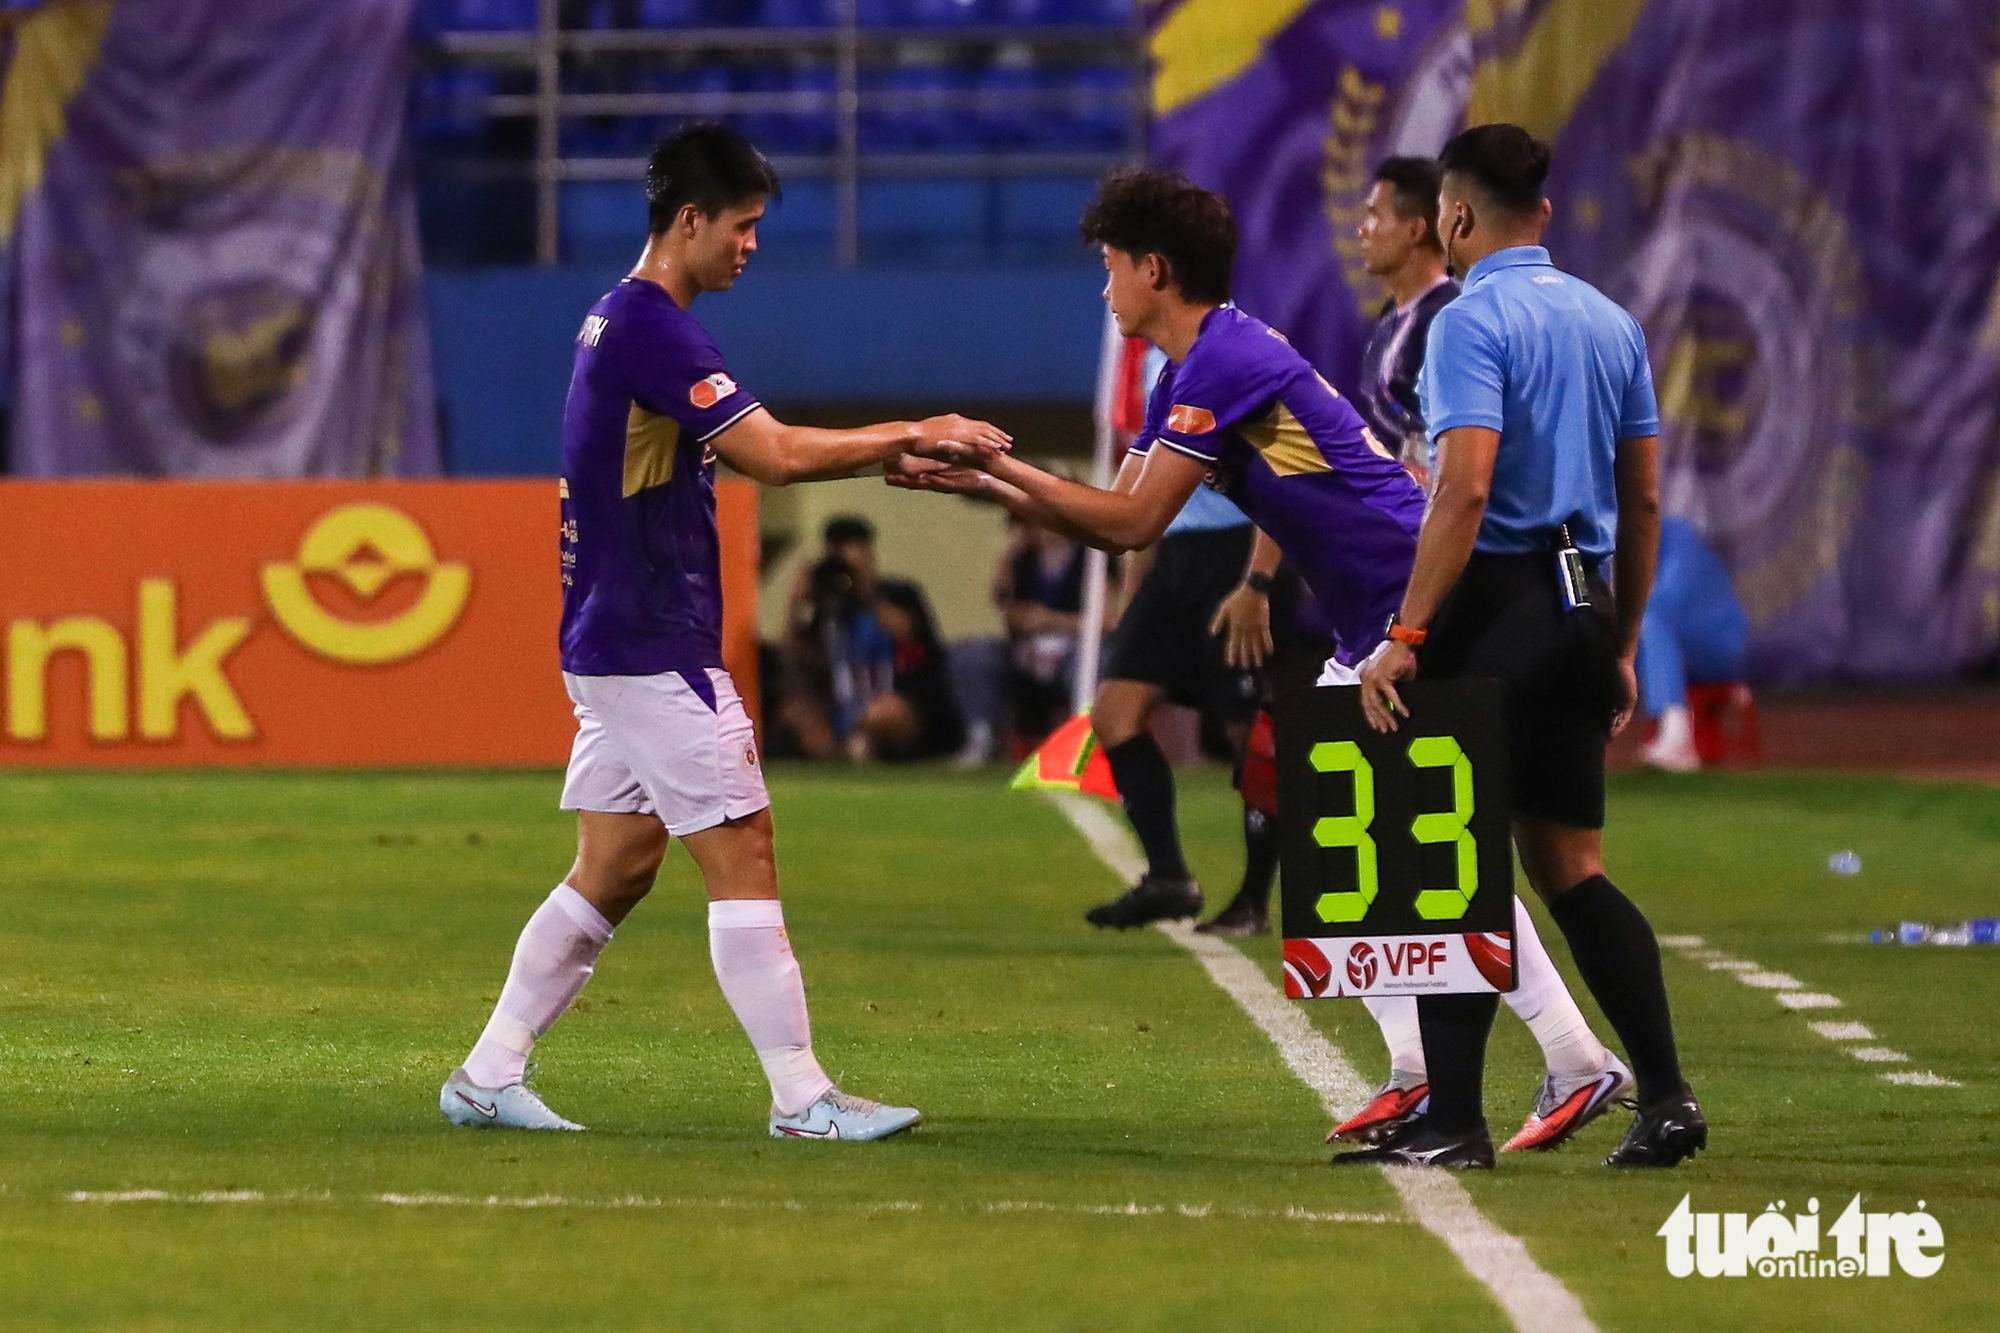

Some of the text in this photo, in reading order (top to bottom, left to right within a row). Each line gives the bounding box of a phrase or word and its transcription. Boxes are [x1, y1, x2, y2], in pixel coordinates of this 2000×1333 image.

[8, 577, 255, 740] nk
[1309, 735, 1479, 923] 33
[1382, 941, 1447, 976] VPF
